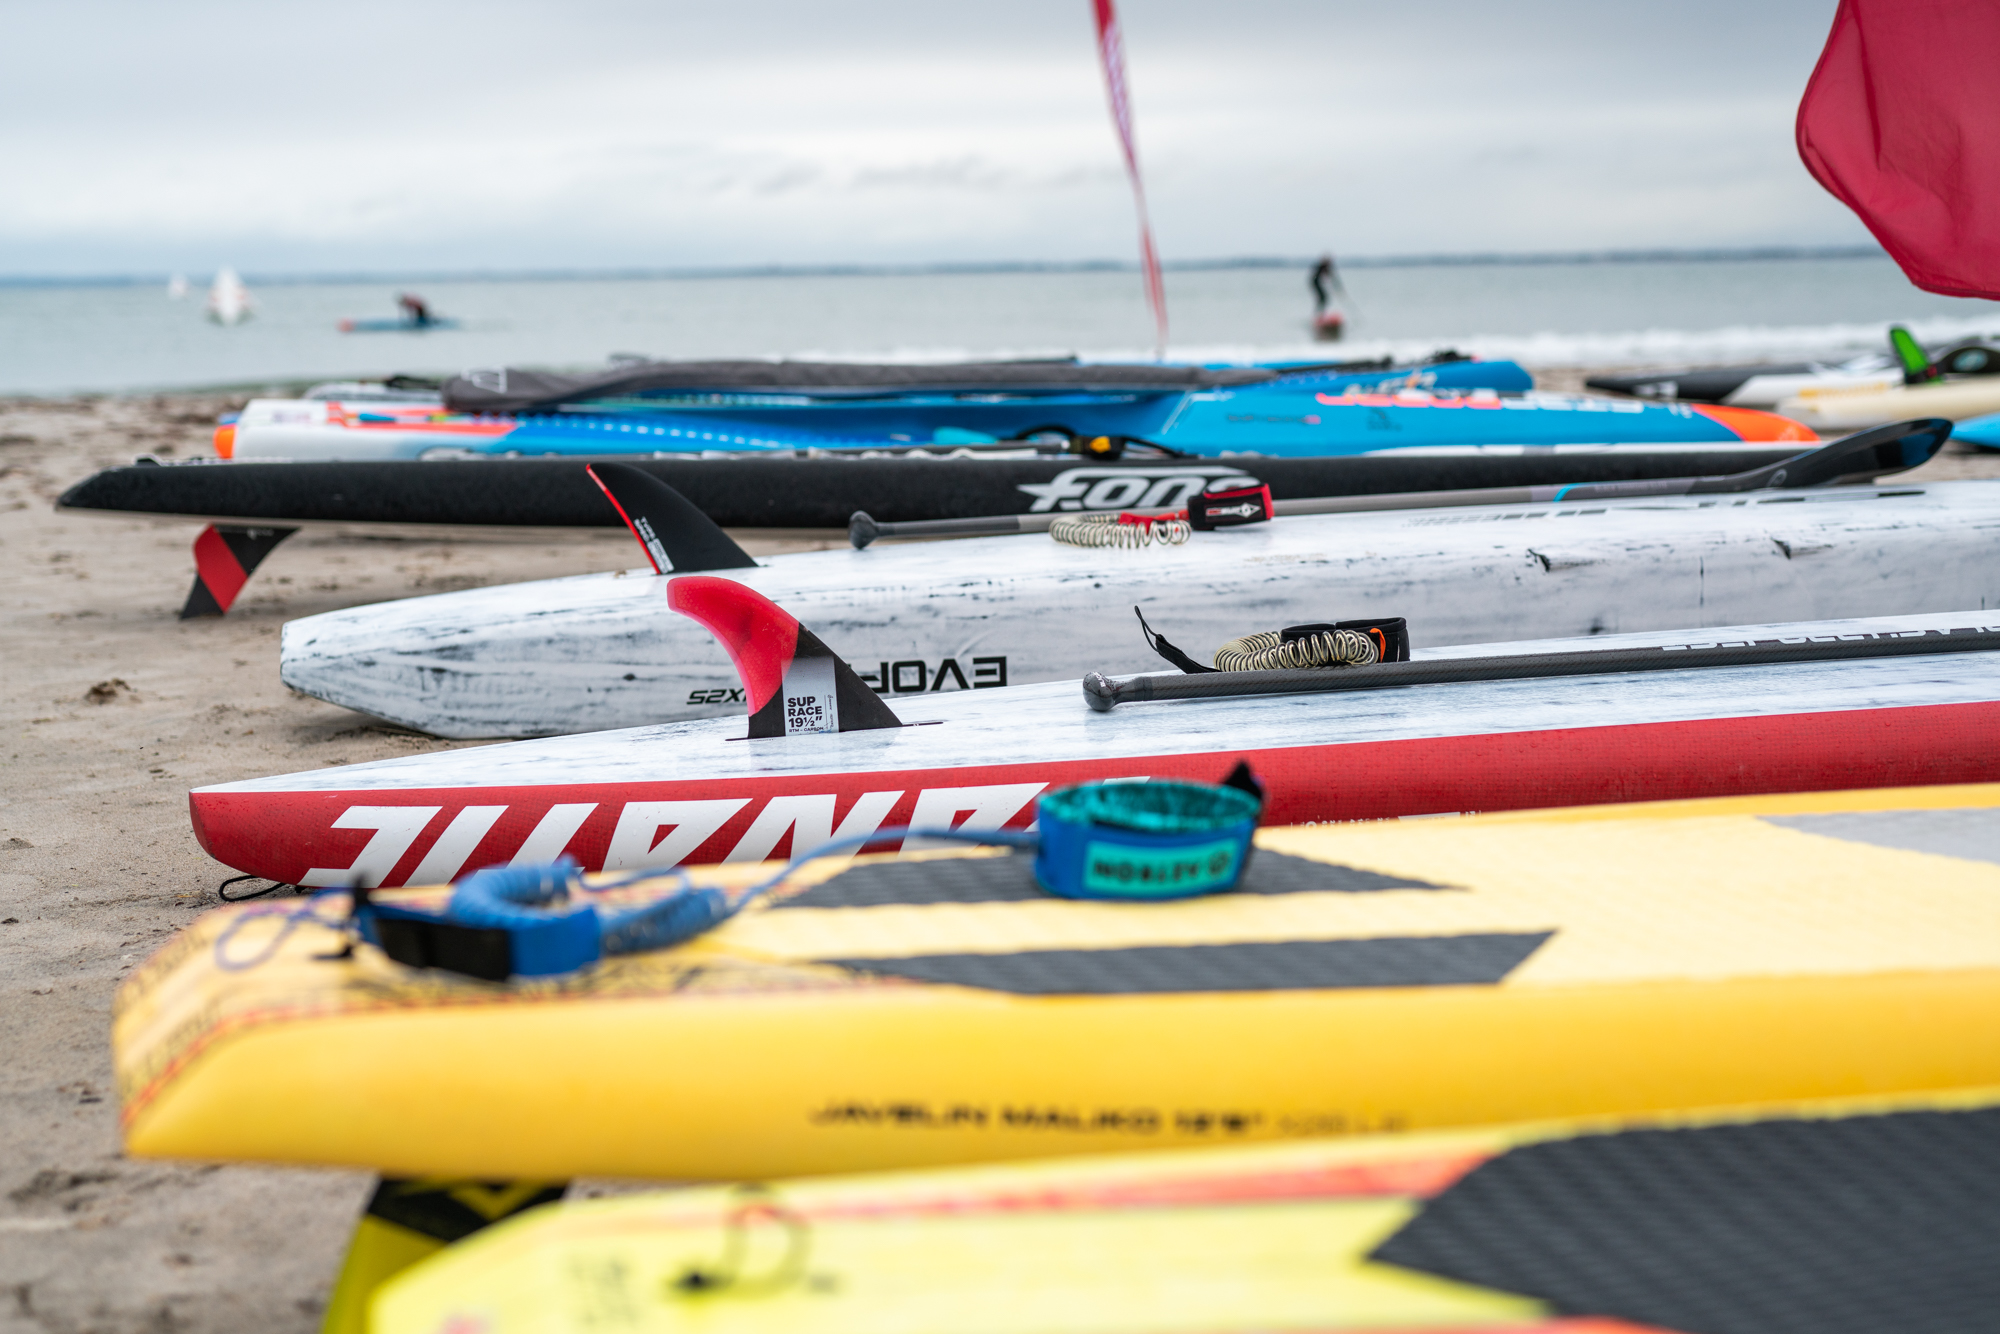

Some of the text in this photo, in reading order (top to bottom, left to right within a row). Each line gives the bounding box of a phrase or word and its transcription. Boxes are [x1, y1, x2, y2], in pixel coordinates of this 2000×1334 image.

[686, 688, 747, 706] X25
[788, 696, 816, 707] SUP
[788, 706, 822, 717] RACE
[302, 776, 1151, 889] ANATIC
[809, 1101, 990, 1128] JAVELIN
[1001, 1103, 1163, 1132] MALIKO
